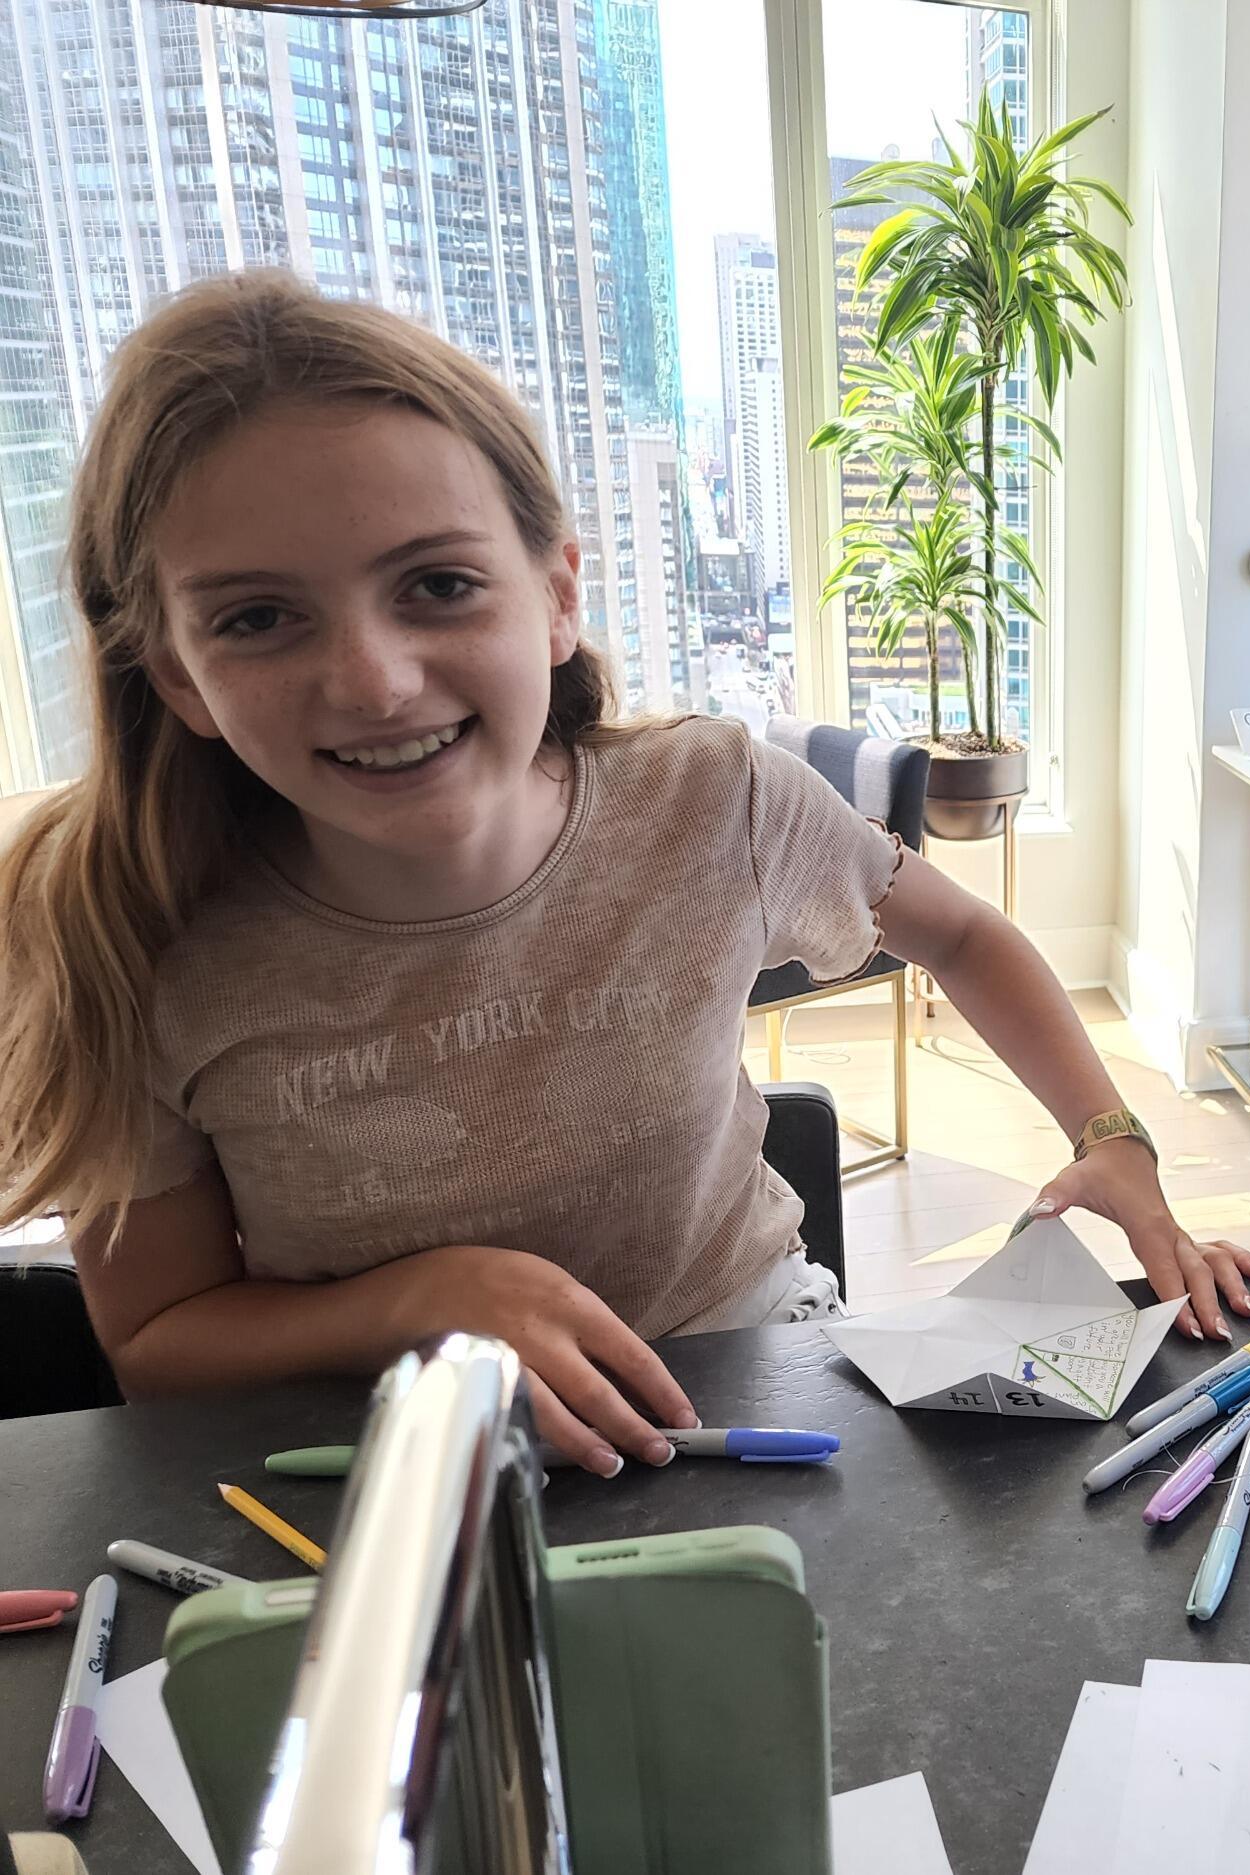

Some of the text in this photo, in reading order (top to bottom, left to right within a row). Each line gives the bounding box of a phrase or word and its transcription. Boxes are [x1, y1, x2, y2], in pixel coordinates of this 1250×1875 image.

[274, 986, 672, 1124] NEW YORK CITY
[1092, 1114, 1126, 1139] GA
[949, 1391, 1045, 1408] 14 13
